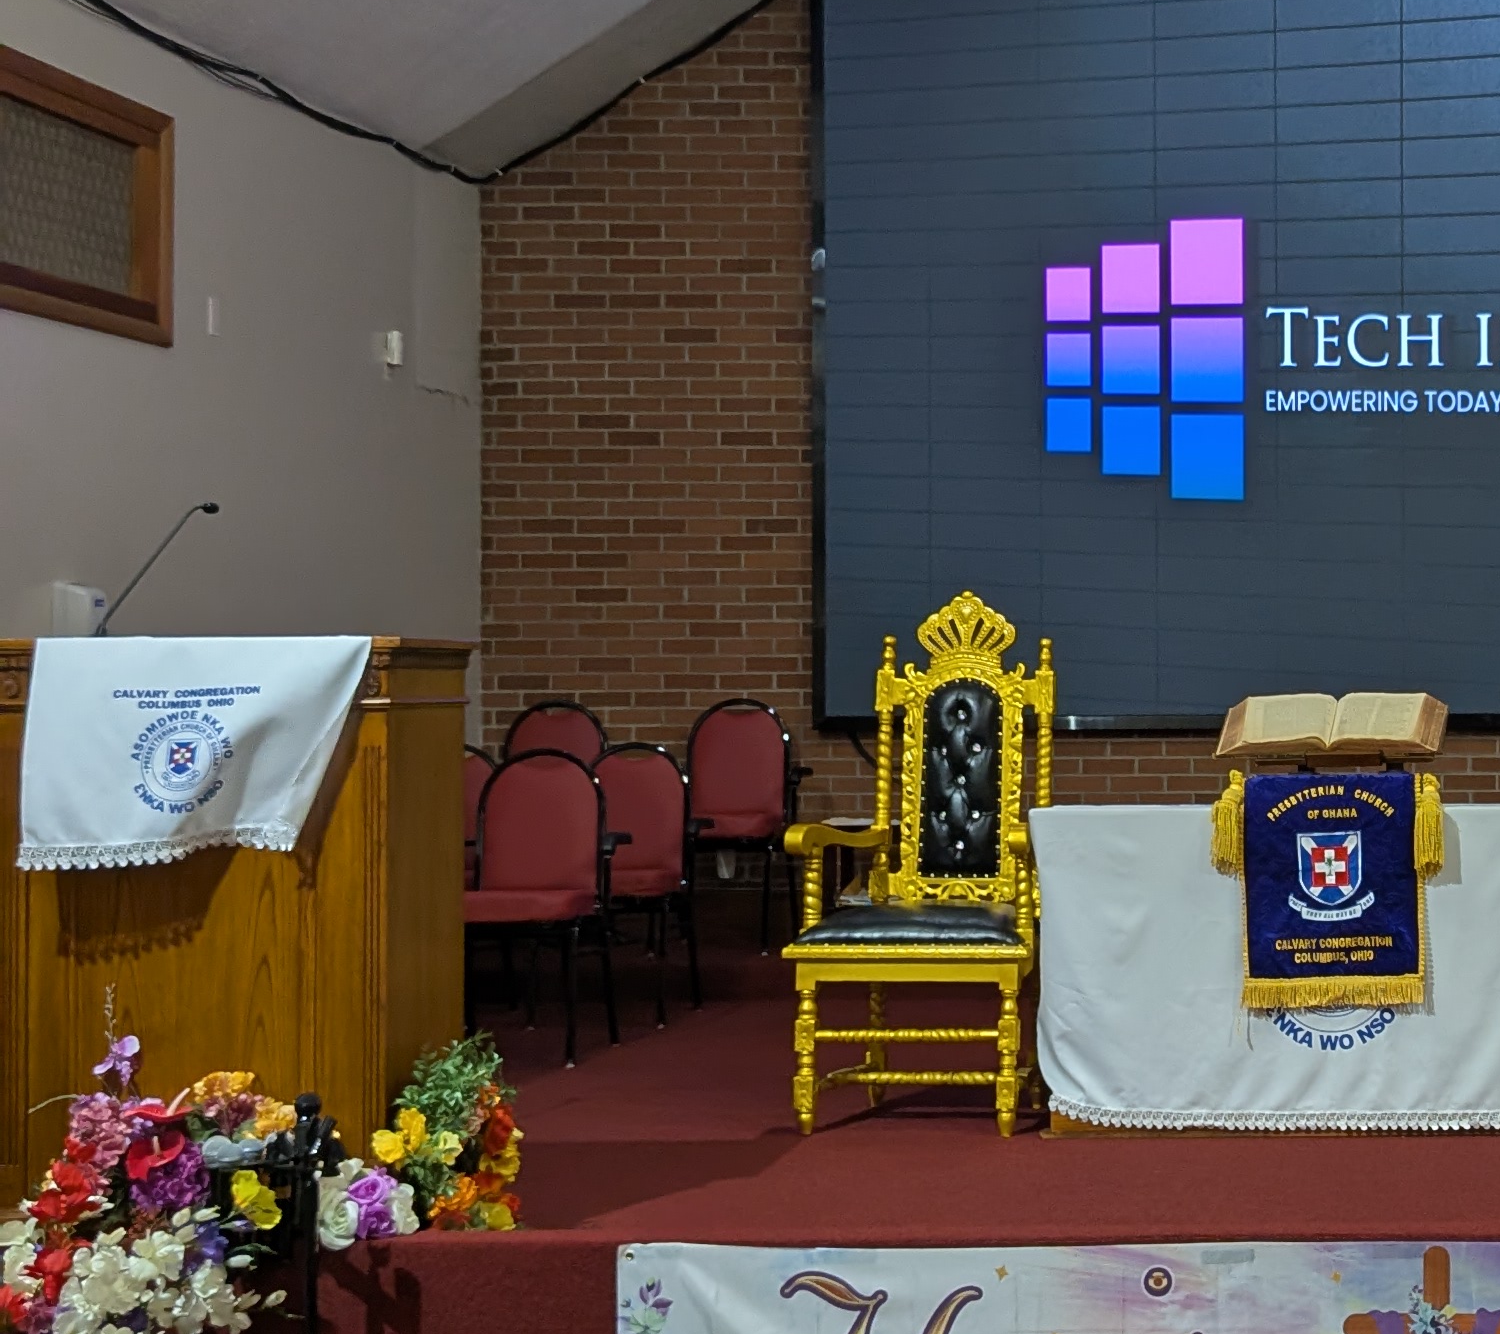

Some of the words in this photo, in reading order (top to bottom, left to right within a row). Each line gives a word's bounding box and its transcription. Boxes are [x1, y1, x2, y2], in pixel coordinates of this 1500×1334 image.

[1265, 389, 1418, 413] EMPOWERING
[113, 689, 169, 699] CALVARY
[174, 686, 261, 698] CONGREGATION
[138, 700, 202, 709] COLUMBUS
[207, 698, 235, 707] OHIO
[202, 713, 224, 735] NKA
[221, 737, 233, 758] WO
[1267, 785, 1344, 822] PRESBYTERIAN
[1354, 789, 1395, 817] CHURCH
[1307, 809, 1319, 819] OF
[1322, 808, 1357, 818] GHANA
[1275, 938, 1317, 950] CALVARY
[1319, 936, 1393, 948] CONGREGATION
[1294, 951, 1349, 964] COLUMBUS,
[1350, 950, 1374, 961] OHIO
[1268, 1009, 1313, 1048] NKA
[1319, 1034, 1354, 1050] WO
[1356, 1007, 1395, 1044] NSO
